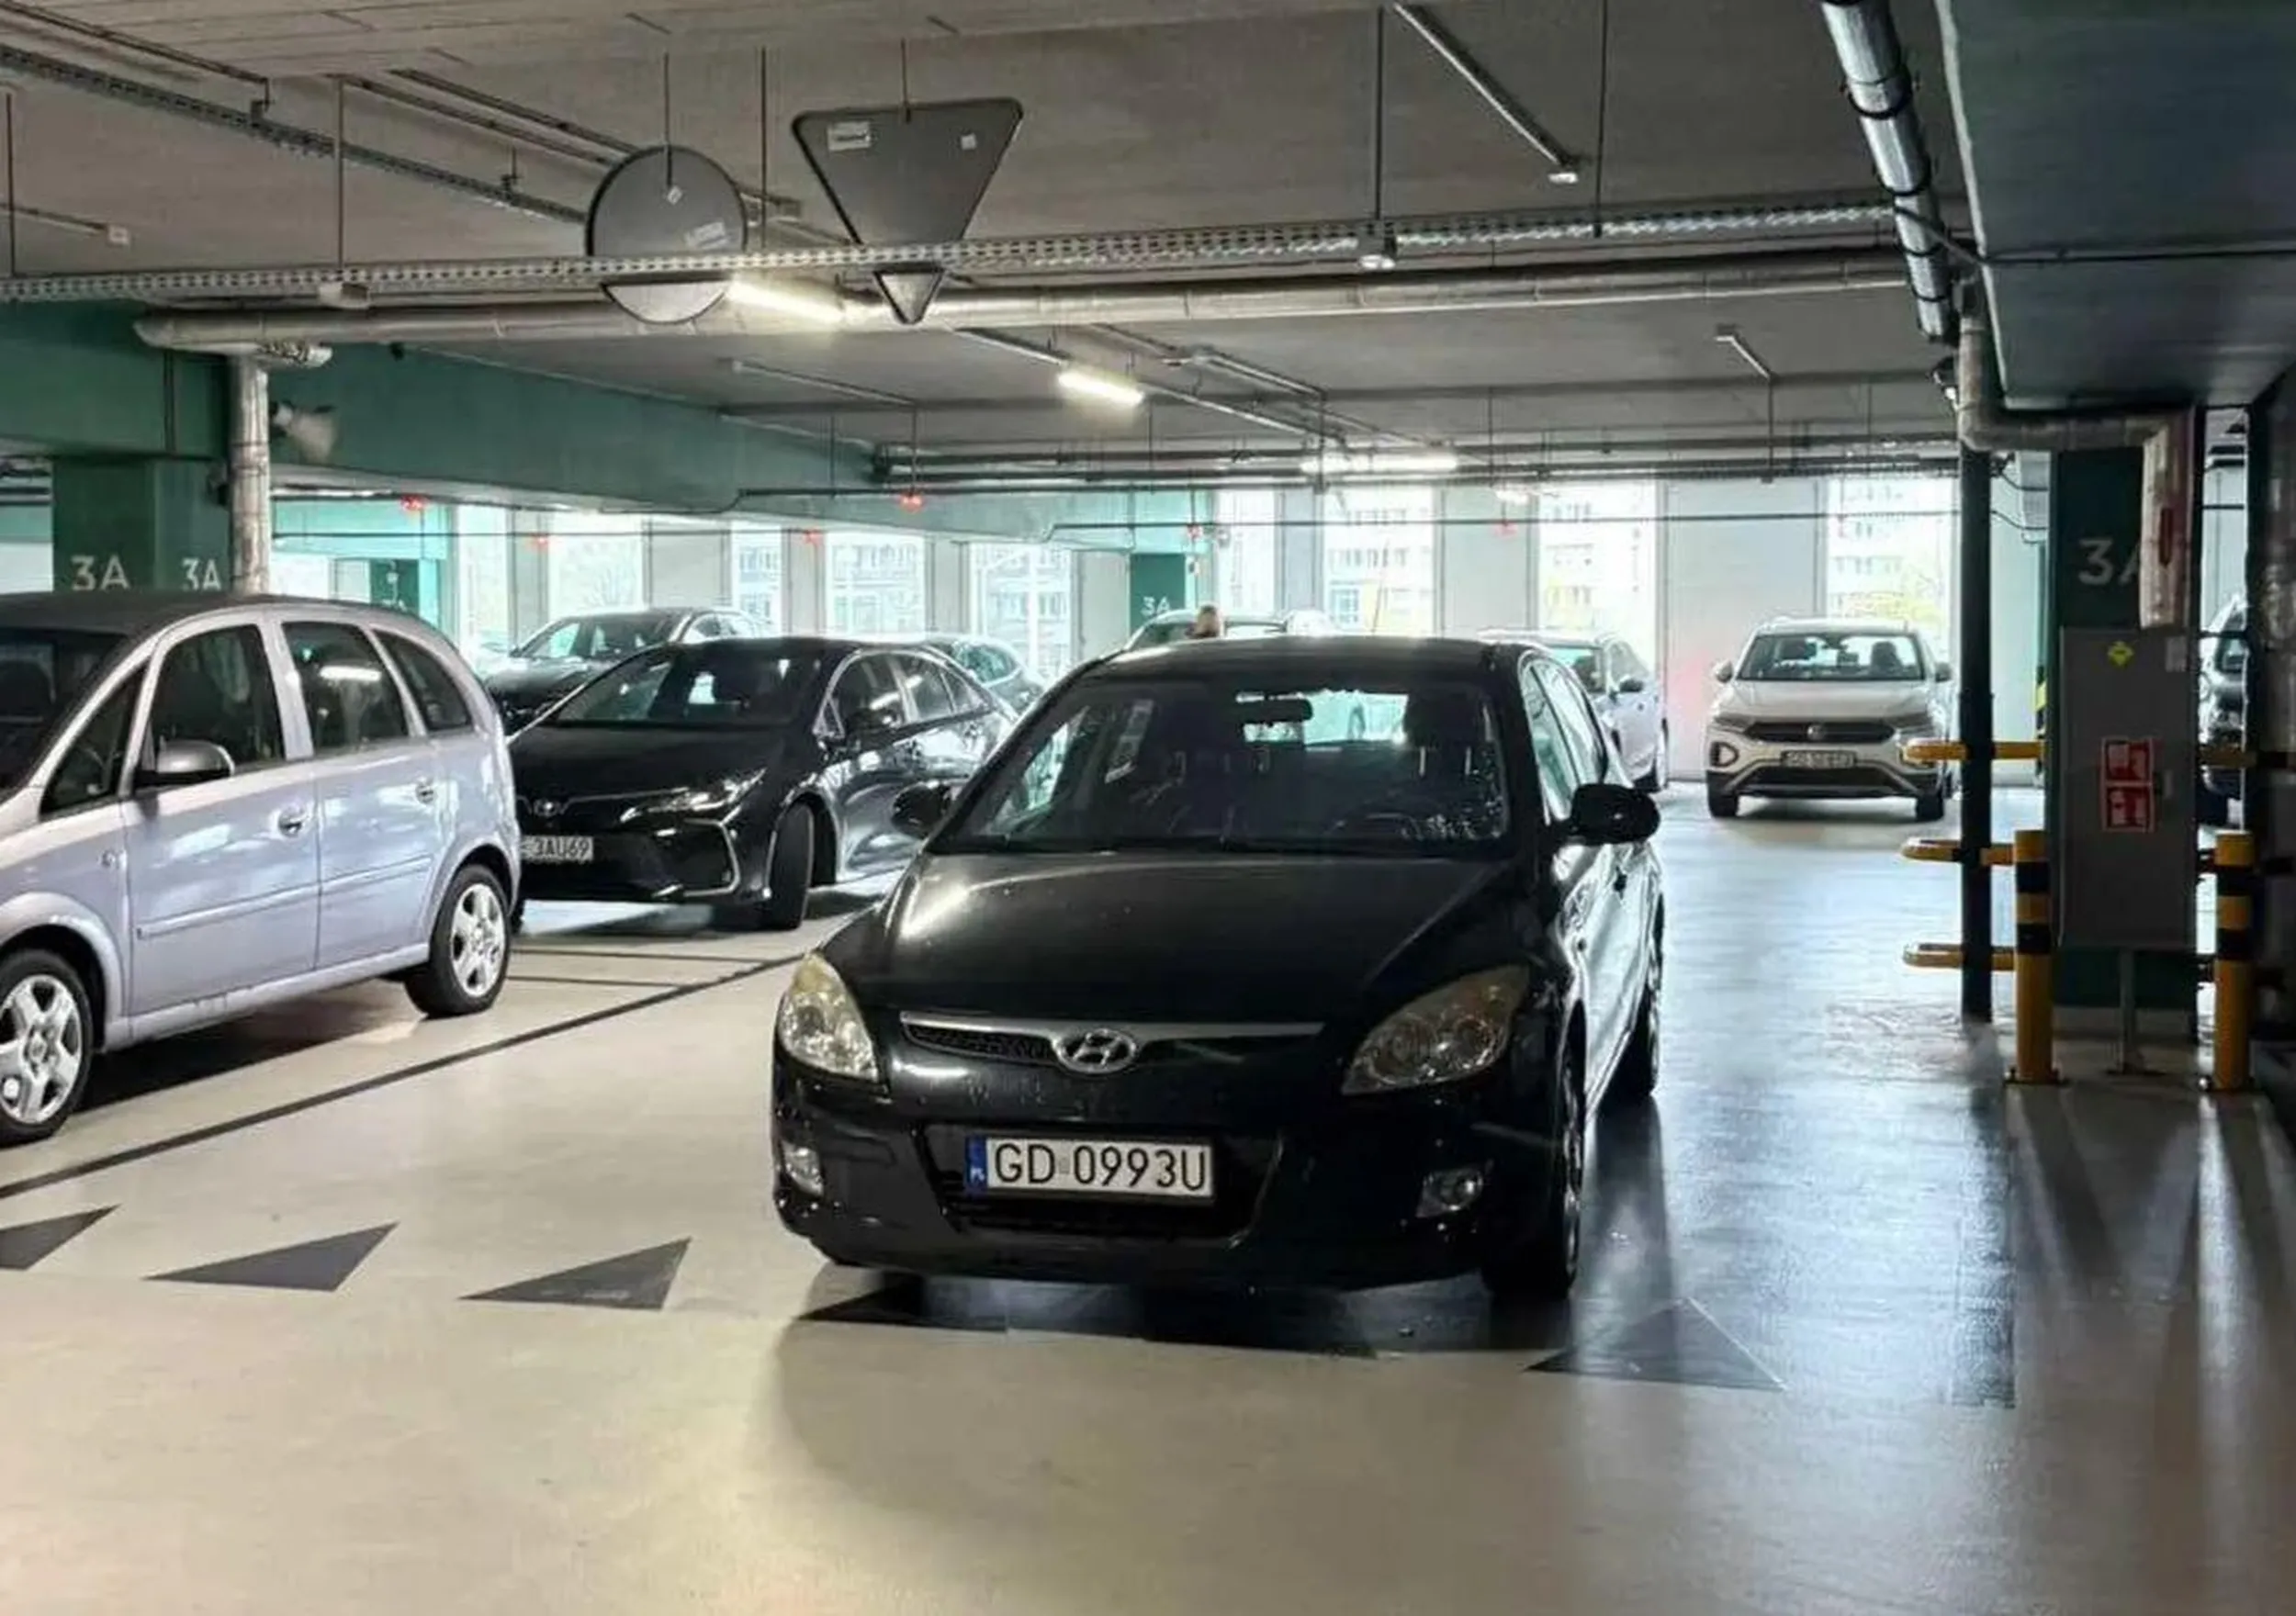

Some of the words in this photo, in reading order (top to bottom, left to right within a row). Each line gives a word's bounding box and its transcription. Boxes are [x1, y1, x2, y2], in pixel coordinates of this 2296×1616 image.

[71, 554, 130, 591] 3A
[183, 557, 221, 590] 3A
[1141, 596, 1171, 616] 3A
[995, 1144, 1055, 1184] GD
[1074, 1145, 1205, 1192] 0993U
